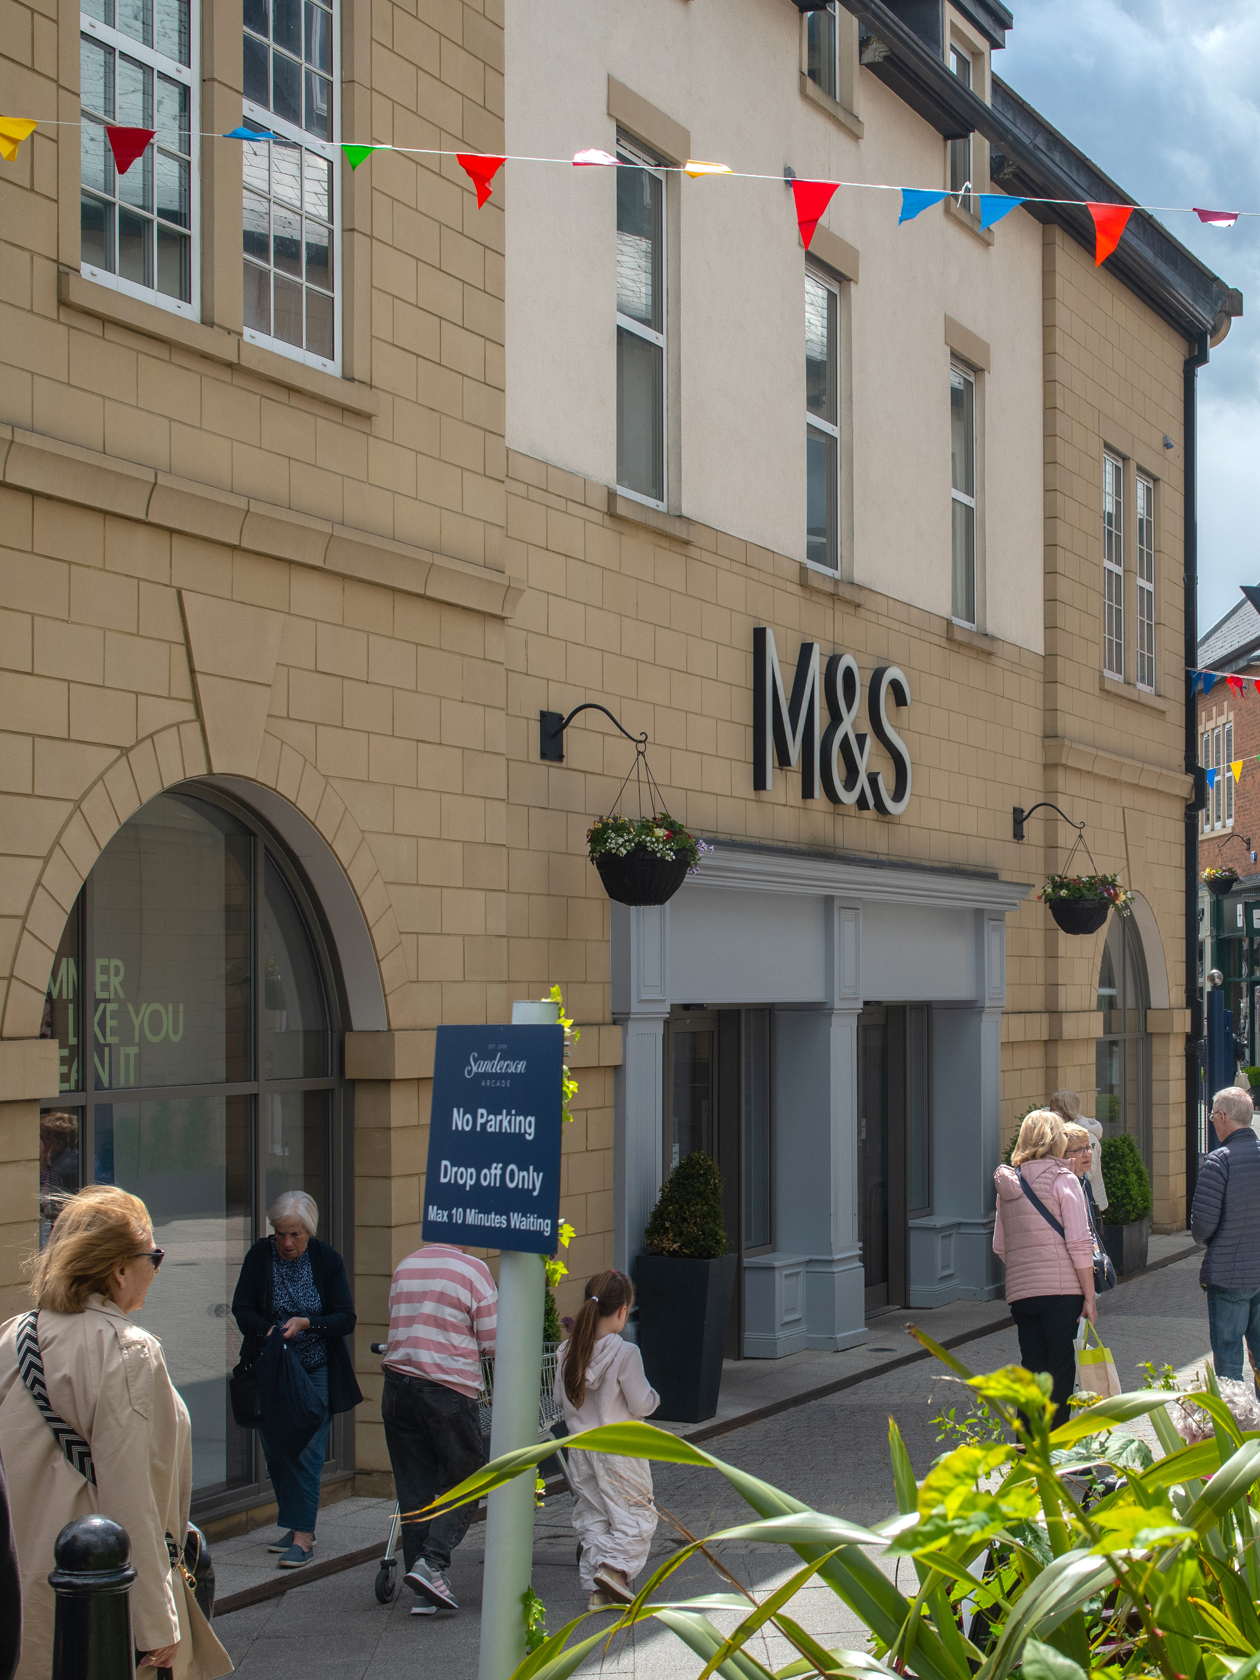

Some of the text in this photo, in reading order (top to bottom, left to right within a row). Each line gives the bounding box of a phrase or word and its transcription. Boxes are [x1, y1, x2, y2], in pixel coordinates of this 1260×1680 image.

[753, 627, 912, 816] M&S
[68, 1002, 184, 1045] LKE YOU
[119, 1046, 139, 1087] IT
[464, 1052, 527, 1078] Sanderson
[452, 1108, 535, 1140] No Parking
[440, 1160, 543, 1196] Drop off Only
[428, 1205, 551, 1236] Max 10 Minutes Waiting
